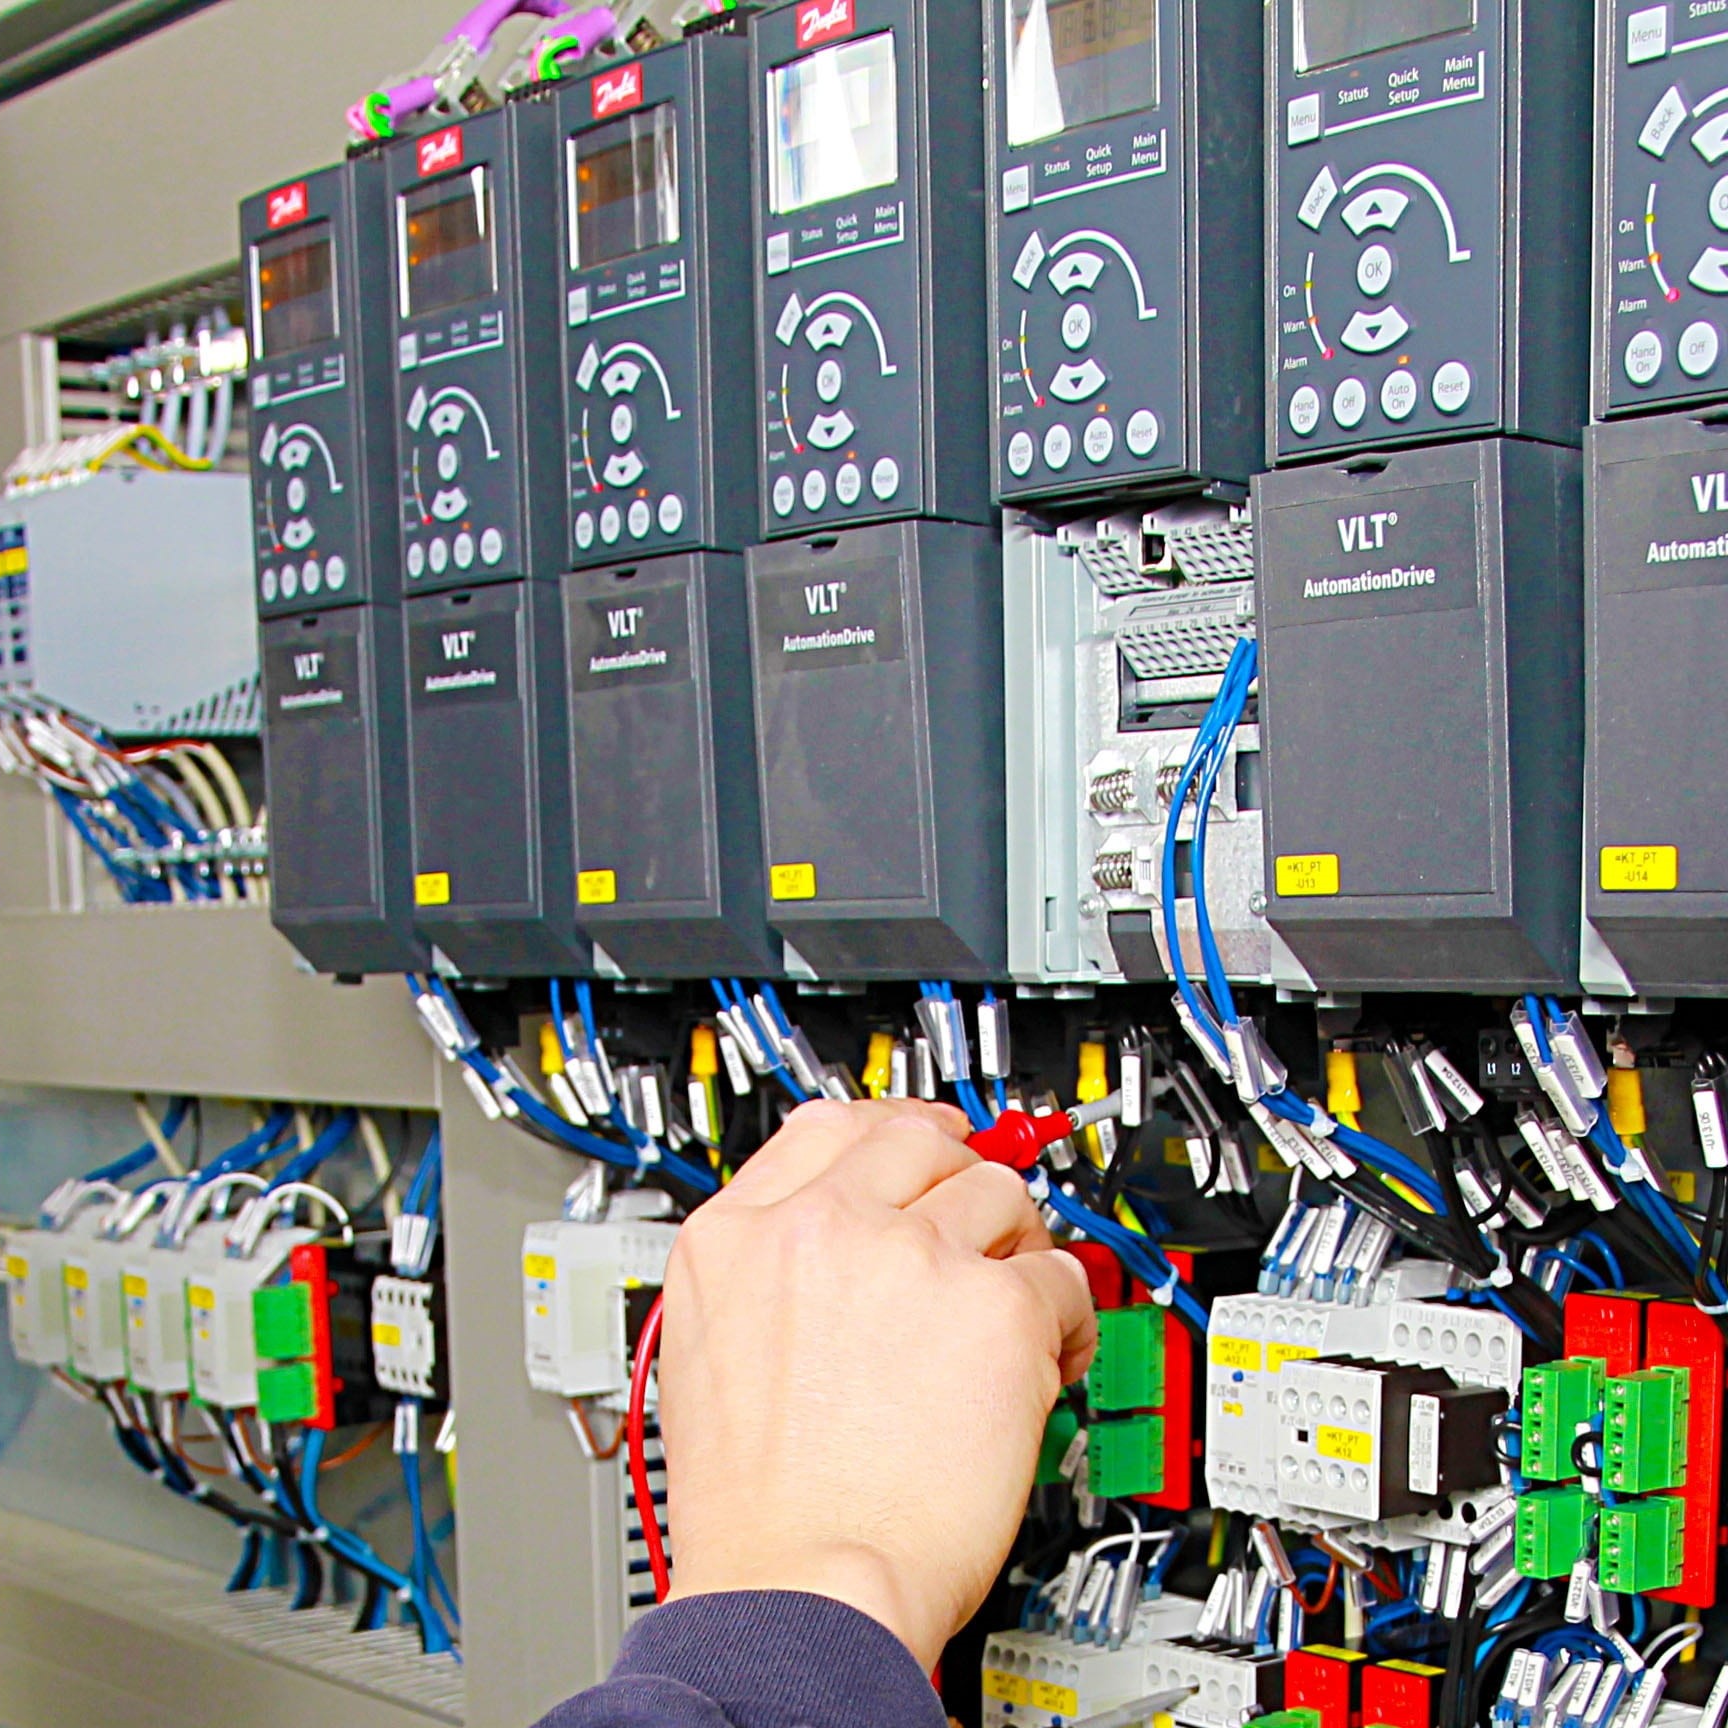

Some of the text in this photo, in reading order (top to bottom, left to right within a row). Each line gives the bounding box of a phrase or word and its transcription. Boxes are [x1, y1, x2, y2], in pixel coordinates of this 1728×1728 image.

[1631, 26, 1663, 44] Menu
[1444, 56, 1473, 73] Main
[1388, 68, 1419, 88] Quick
[1442, 74, 1476, 92] Menu
[1338, 86, 1369, 105] Status
[1388, 87, 1420, 106] Setup
[1291, 112, 1317, 128] Menu
[1651, 109, 1674, 140] Back
[1133, 133, 1157, 149] Main
[1086, 144, 1112, 161] Quick
[1131, 151, 1159, 166] Menu
[1044, 160, 1070, 176] Status
[1086, 161, 1113, 177] Setup
[1618, 220, 1634, 233] On
[1365, 265, 1383, 280] OK
[1283, 285, 1296, 298] On
[1617, 298, 1647, 314] Alarm
[1068, 318, 1085, 334] OK
[1283, 355, 1308, 371] Alarm
[1437, 380, 1465, 393] Reset
[1303, 564, 1436, 599] AutomationDrive
[783, 625, 876, 652] AutomationDrive
[1487, 1062, 1497, 1075] L1
[1511, 1062, 1521, 1075] L2
